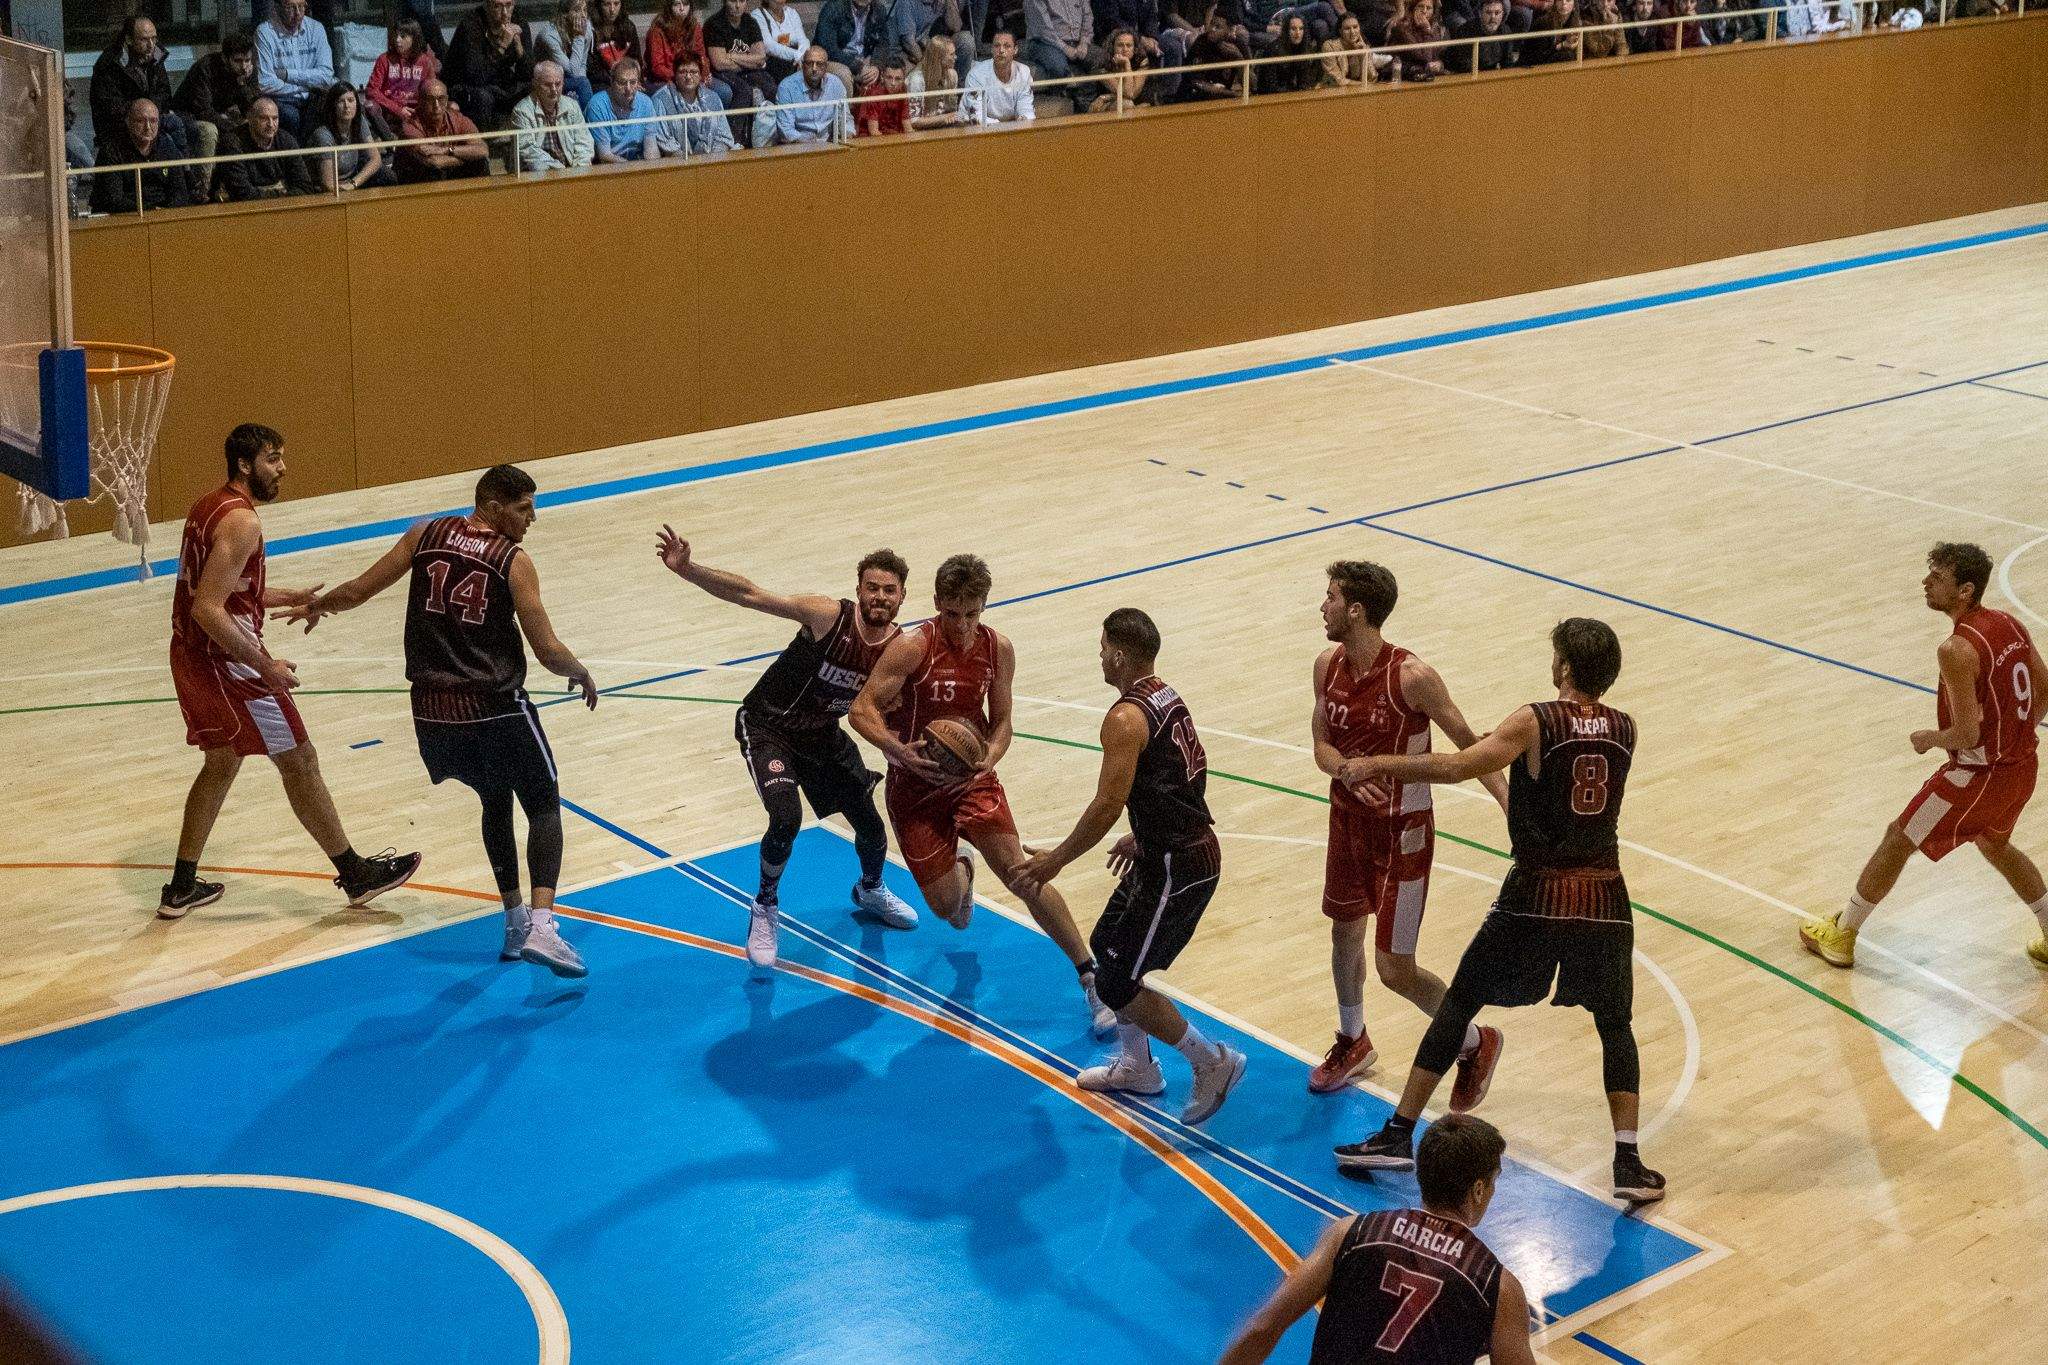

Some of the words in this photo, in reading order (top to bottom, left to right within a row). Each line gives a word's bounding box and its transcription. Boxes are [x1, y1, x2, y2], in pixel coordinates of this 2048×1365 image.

[446, 530, 490, 554] LUISON
[425, 559, 489, 625] 14
[818, 661, 868, 691] UESC
[930, 680, 956, 702] 13
[2013, 662, 2031, 721] 9
[1327, 701, 1349, 730] 22
[1171, 715, 1208, 782] 12
[1571, 753, 1609, 815] 8
[1391, 1216, 1465, 1259] GARCIA
[1375, 1261, 1444, 1353] 7
